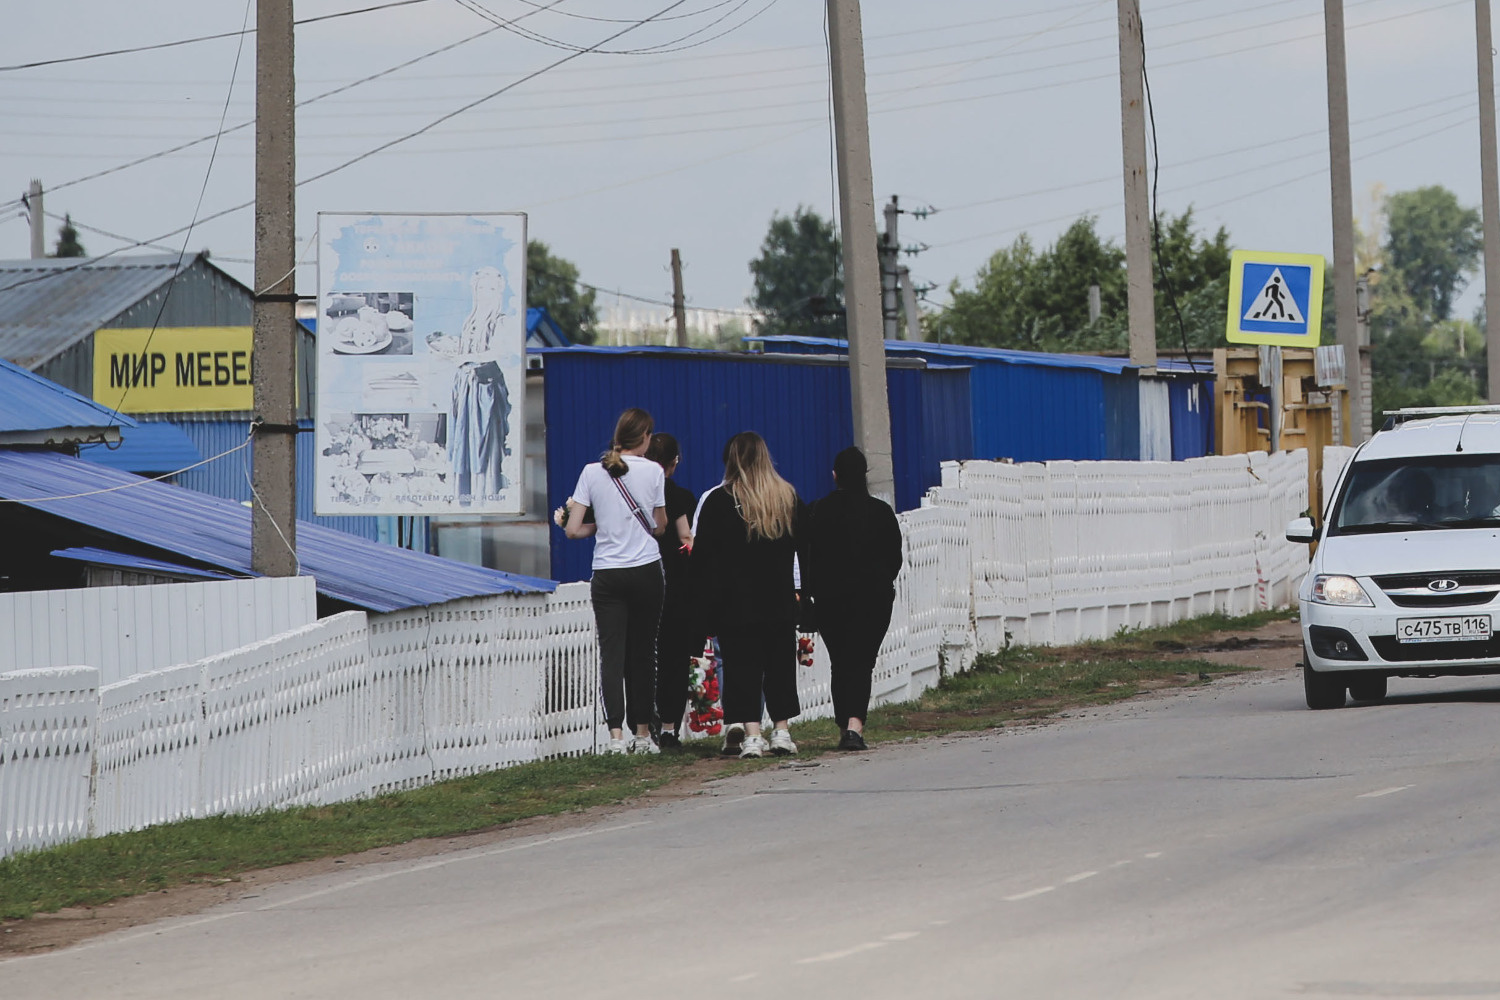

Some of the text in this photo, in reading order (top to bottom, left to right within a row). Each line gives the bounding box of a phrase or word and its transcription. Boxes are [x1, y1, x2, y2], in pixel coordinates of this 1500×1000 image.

[110, 351, 254, 388] МИР МЕБЕ
[1464, 618, 1486, 629] 116
